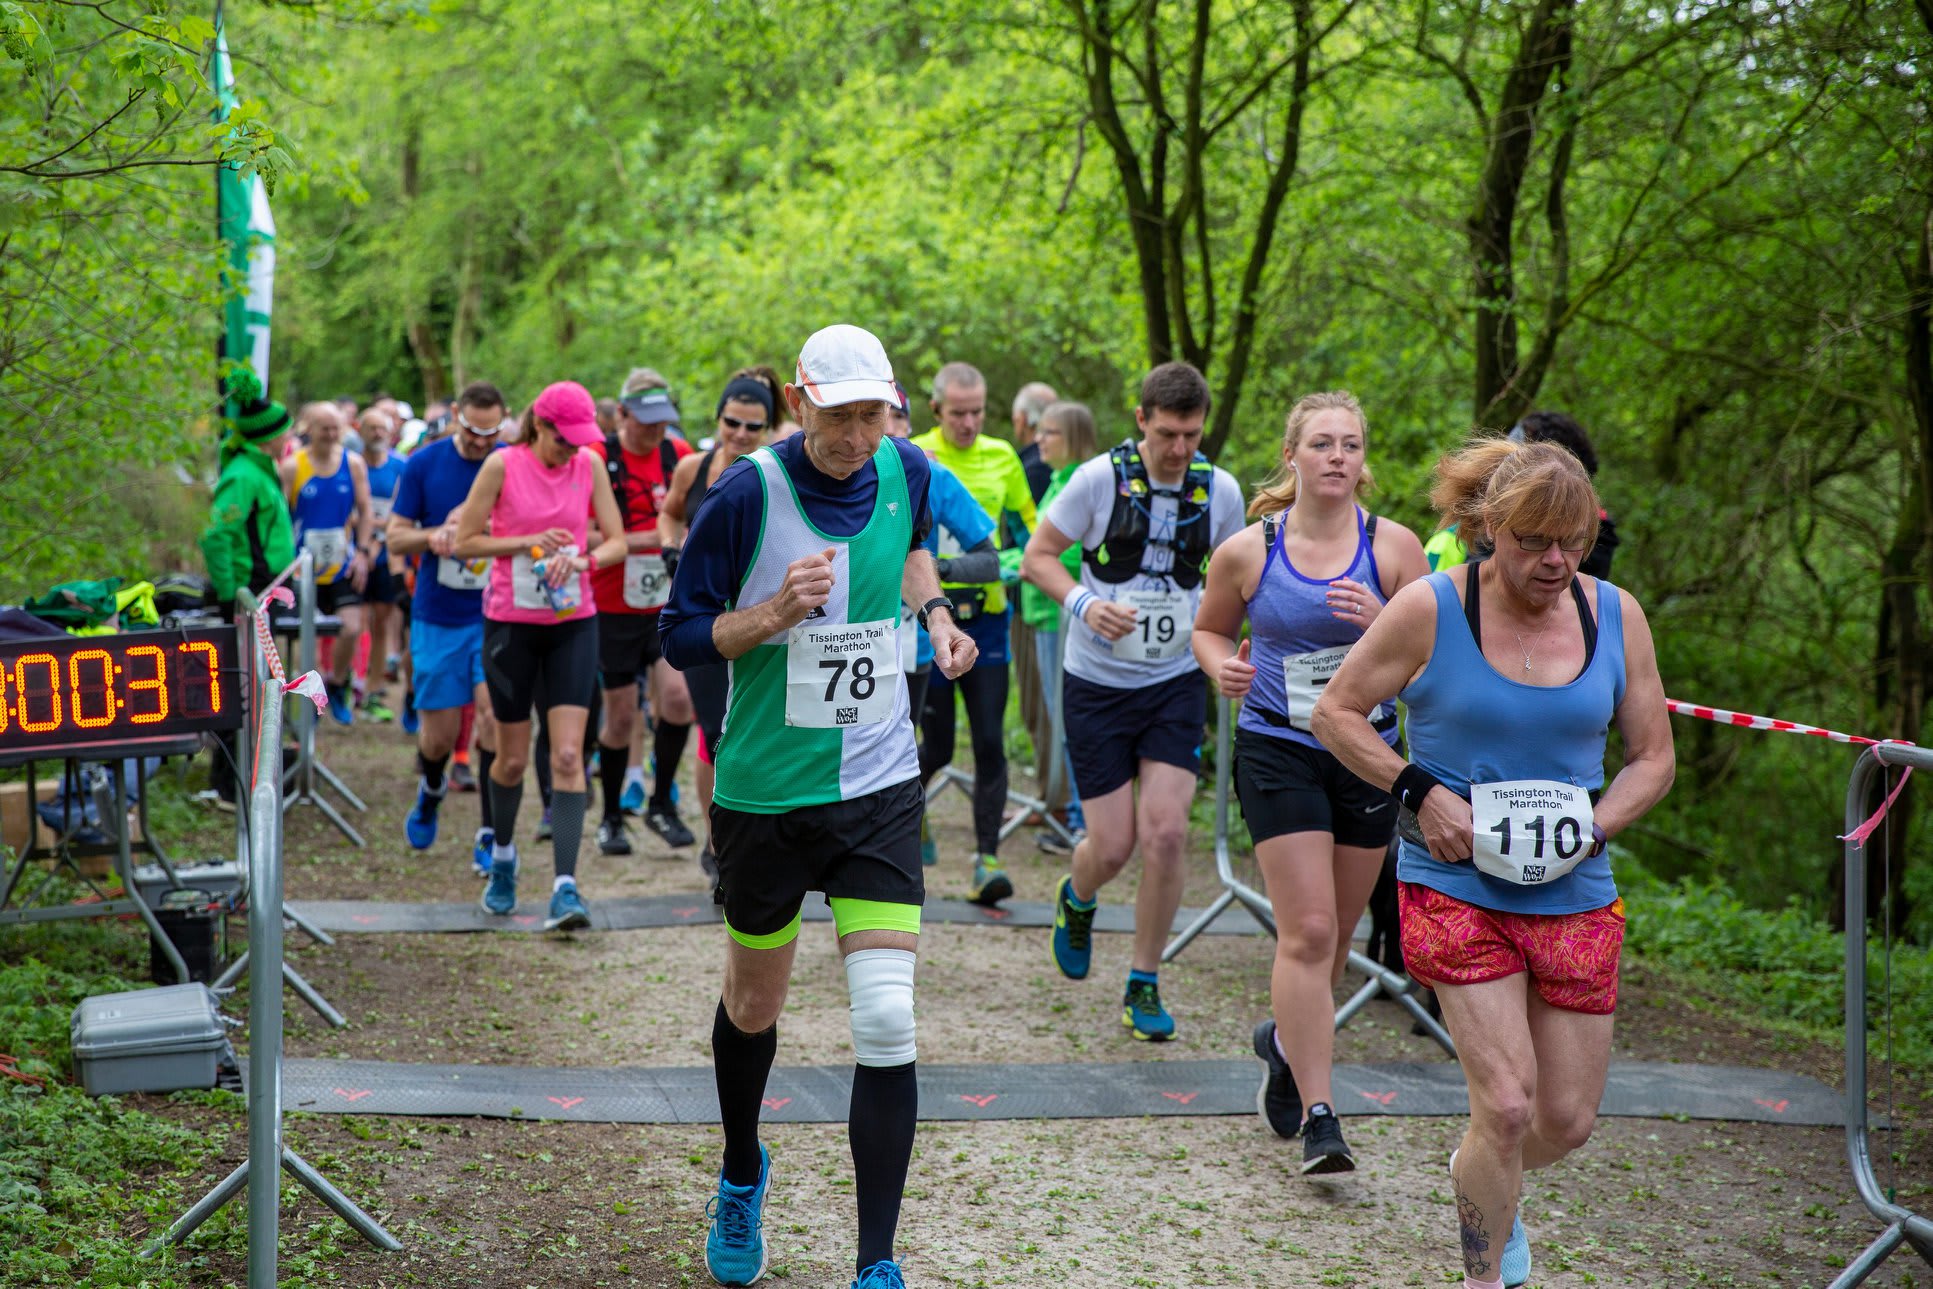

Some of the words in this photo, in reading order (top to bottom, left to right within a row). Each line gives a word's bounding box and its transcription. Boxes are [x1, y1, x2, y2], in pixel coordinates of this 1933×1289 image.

[809, 631, 862, 644] Tissington
[865, 628, 884, 639] Trail
[1137, 615, 1175, 644] 19
[824, 641, 871, 653] Marathon
[0, 641, 221, 733] :00:37
[819, 656, 876, 702] 78
[1492, 788, 1552, 800] Tissington
[1555, 789, 1574, 801] Trail
[1509, 799, 1563, 810] Marathon
[1490, 815, 1583, 860] 110
